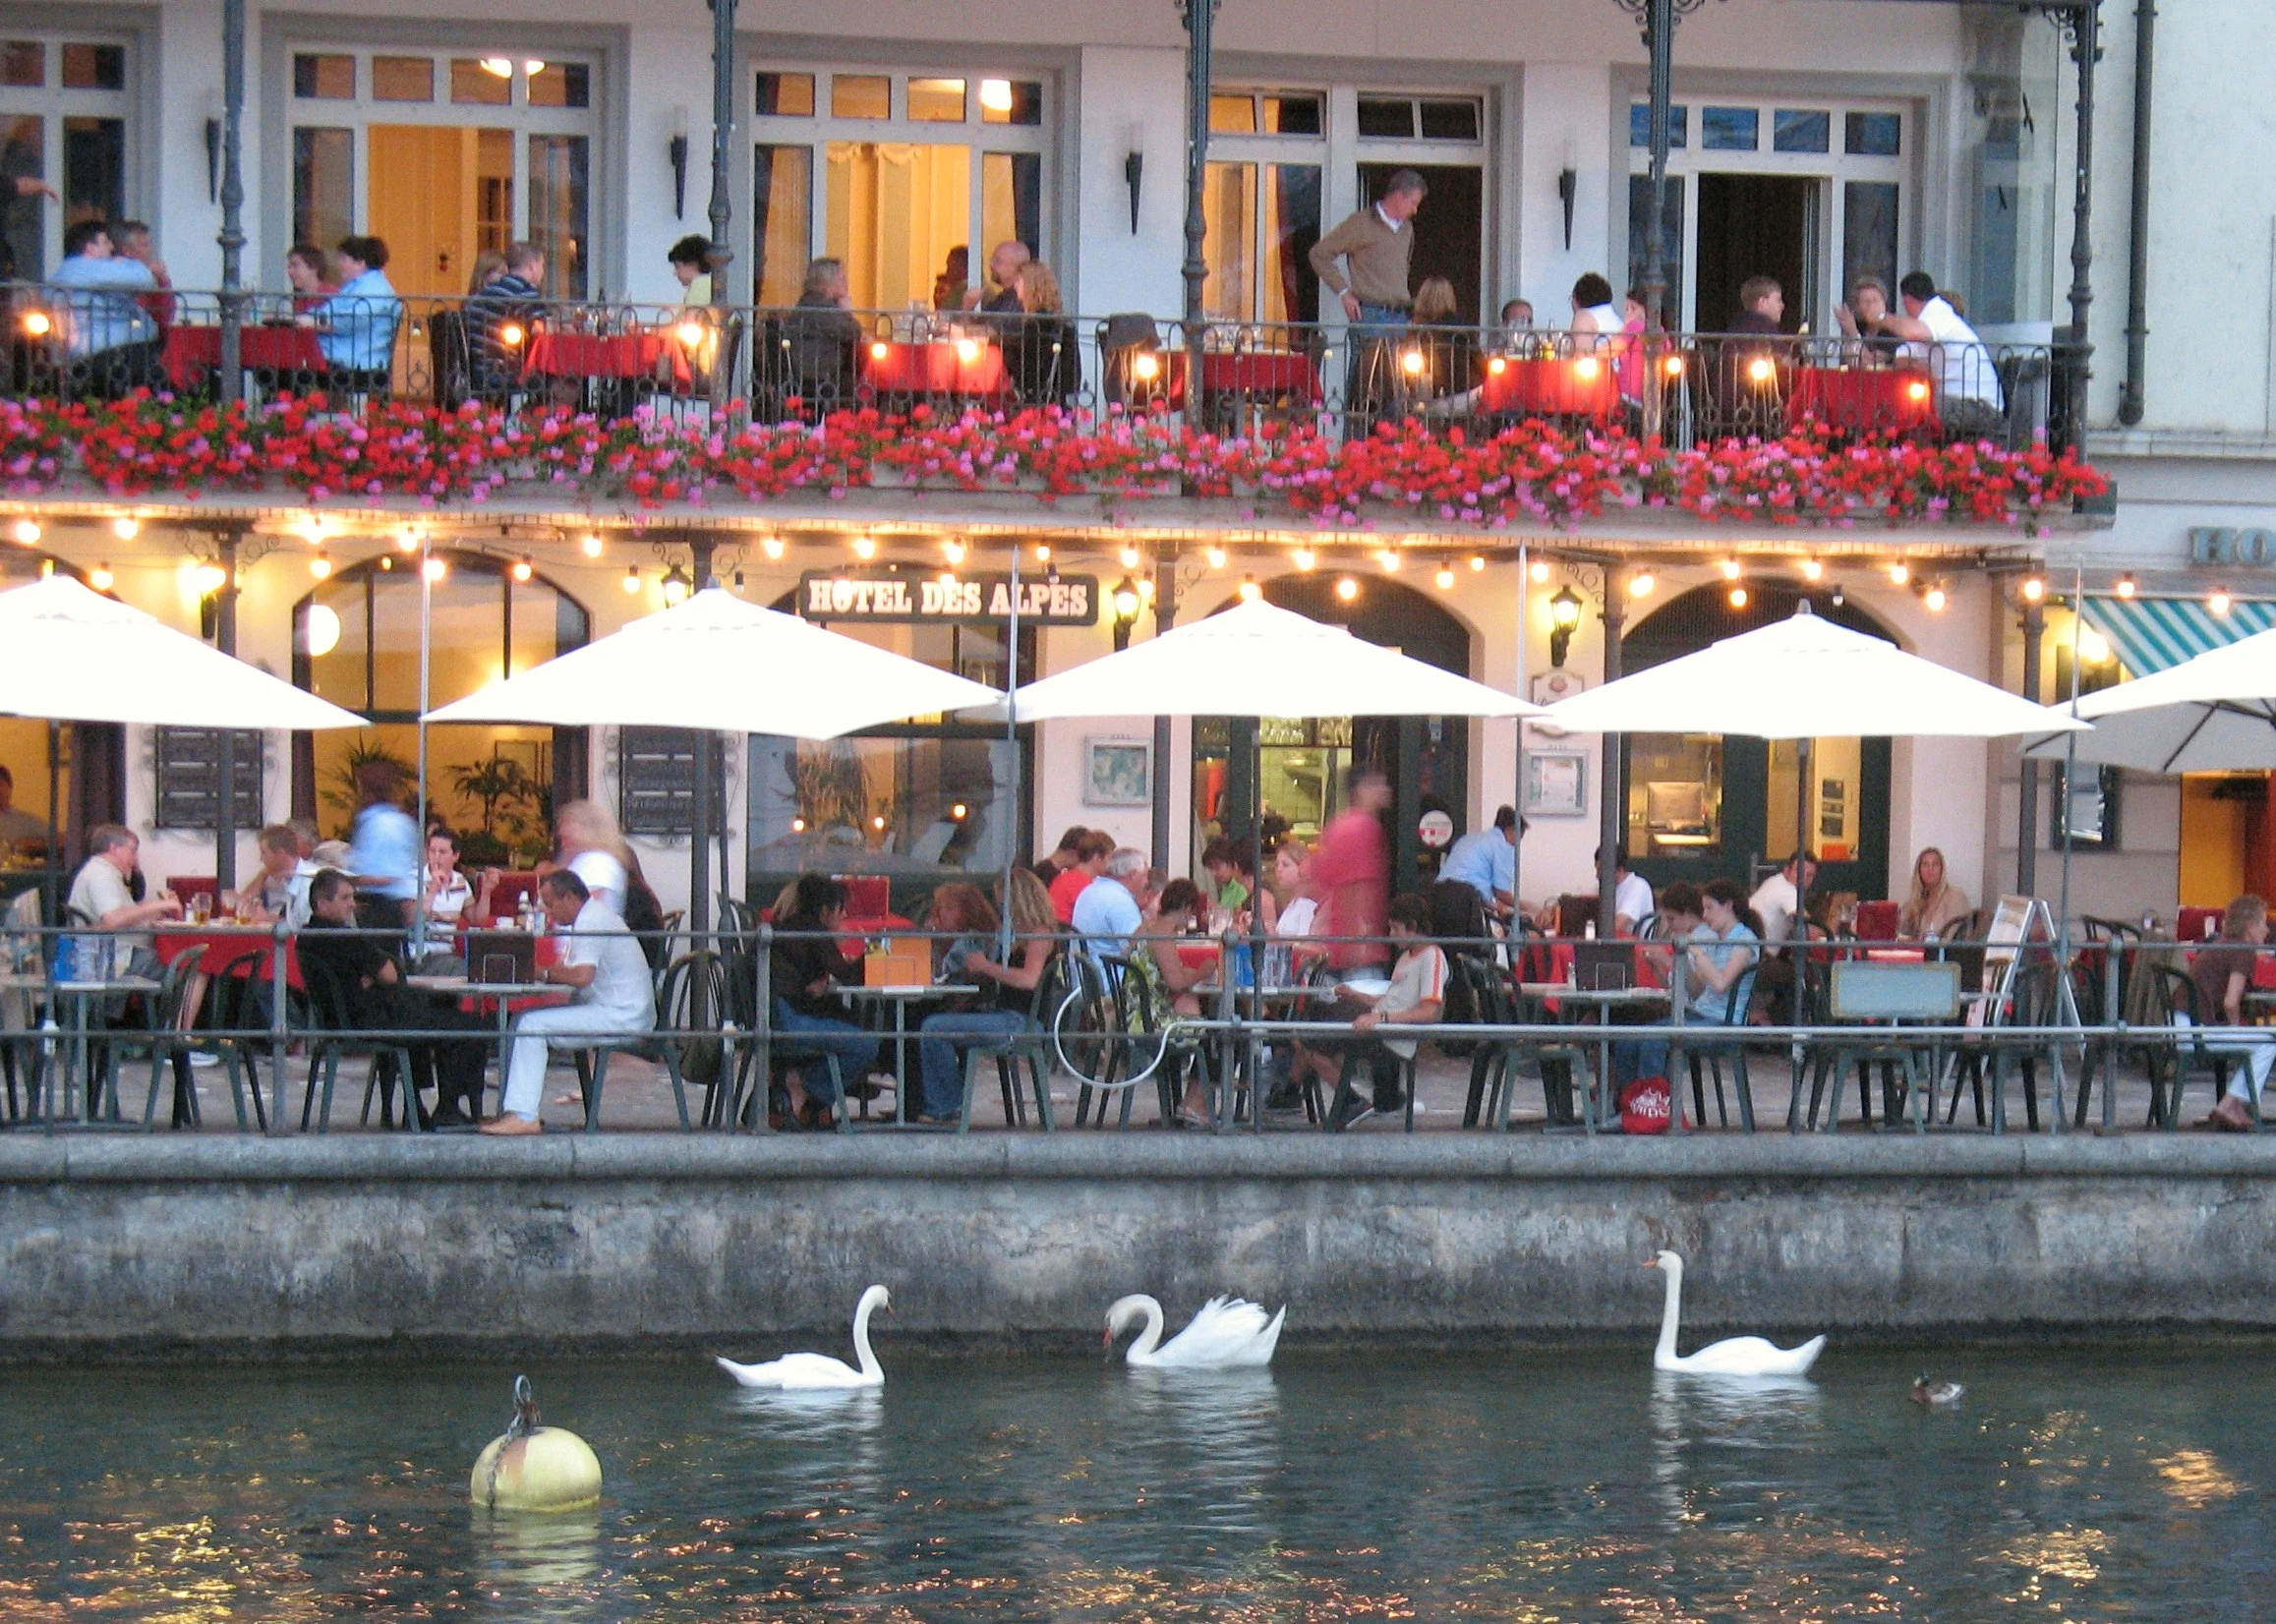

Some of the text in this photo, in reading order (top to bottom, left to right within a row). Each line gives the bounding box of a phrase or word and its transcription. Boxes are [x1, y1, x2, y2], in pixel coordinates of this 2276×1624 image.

[808, 579, 1088, 617] HOTEL DES ALPES
